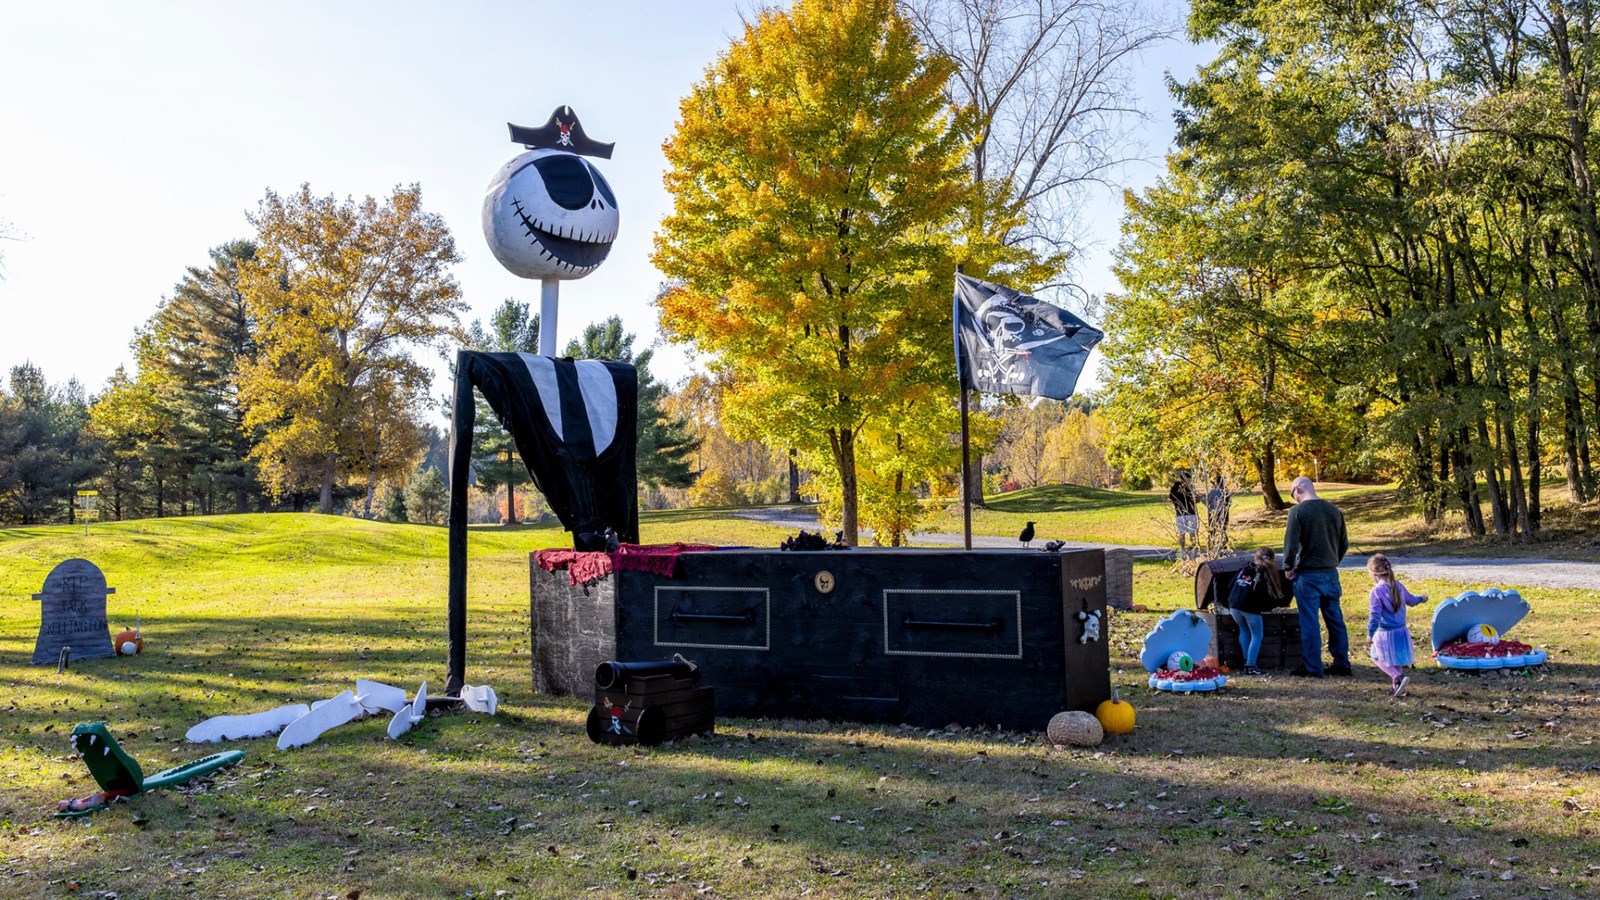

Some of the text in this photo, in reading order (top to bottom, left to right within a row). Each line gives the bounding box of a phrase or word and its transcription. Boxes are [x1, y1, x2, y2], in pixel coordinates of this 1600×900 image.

[62, 576, 88, 592] RIP
[60, 599, 87, 613] JACK
[42, 618, 107, 636] SKELLINGTON
